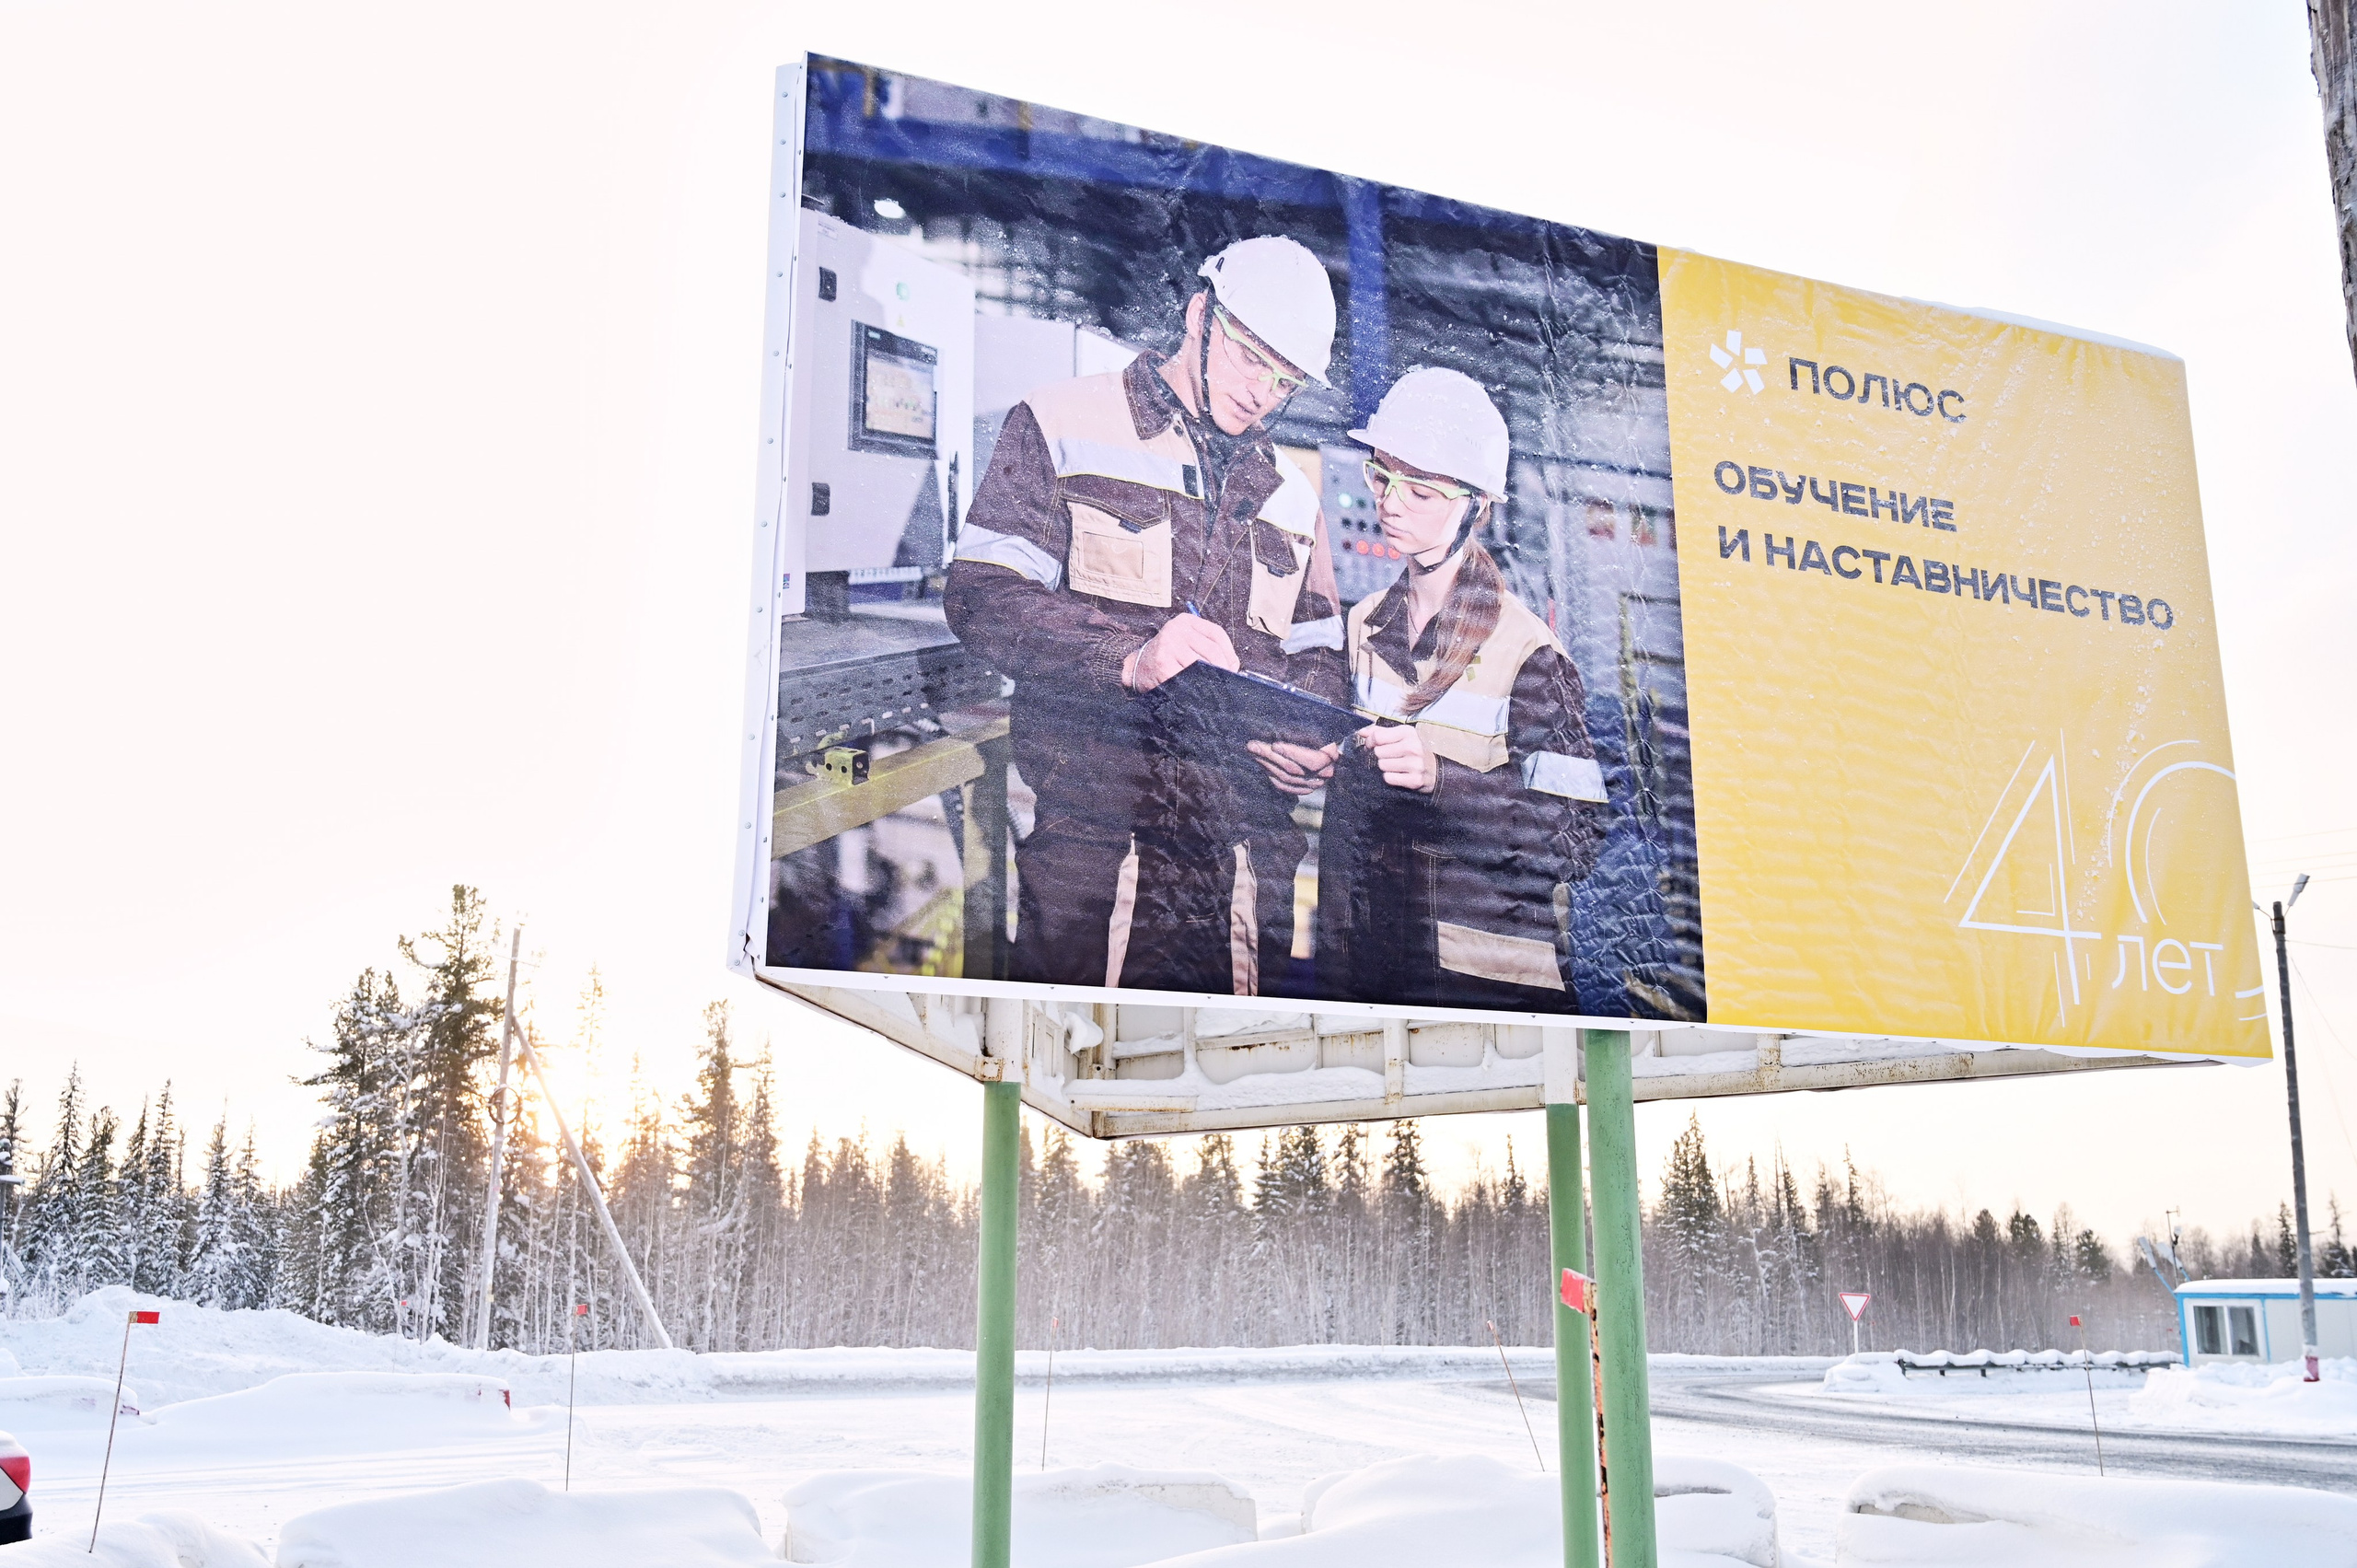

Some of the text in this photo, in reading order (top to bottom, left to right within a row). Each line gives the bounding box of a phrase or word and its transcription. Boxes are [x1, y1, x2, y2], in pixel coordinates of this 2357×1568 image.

[1789, 357, 1967, 423] ПОЛЮС
[1713, 460, 1957, 533] ОБУЧЕНИЕ
[1719, 525, 2174, 630] И НАСТАВНИЧЕСТВО
[2111, 934, 2223, 996] лет
